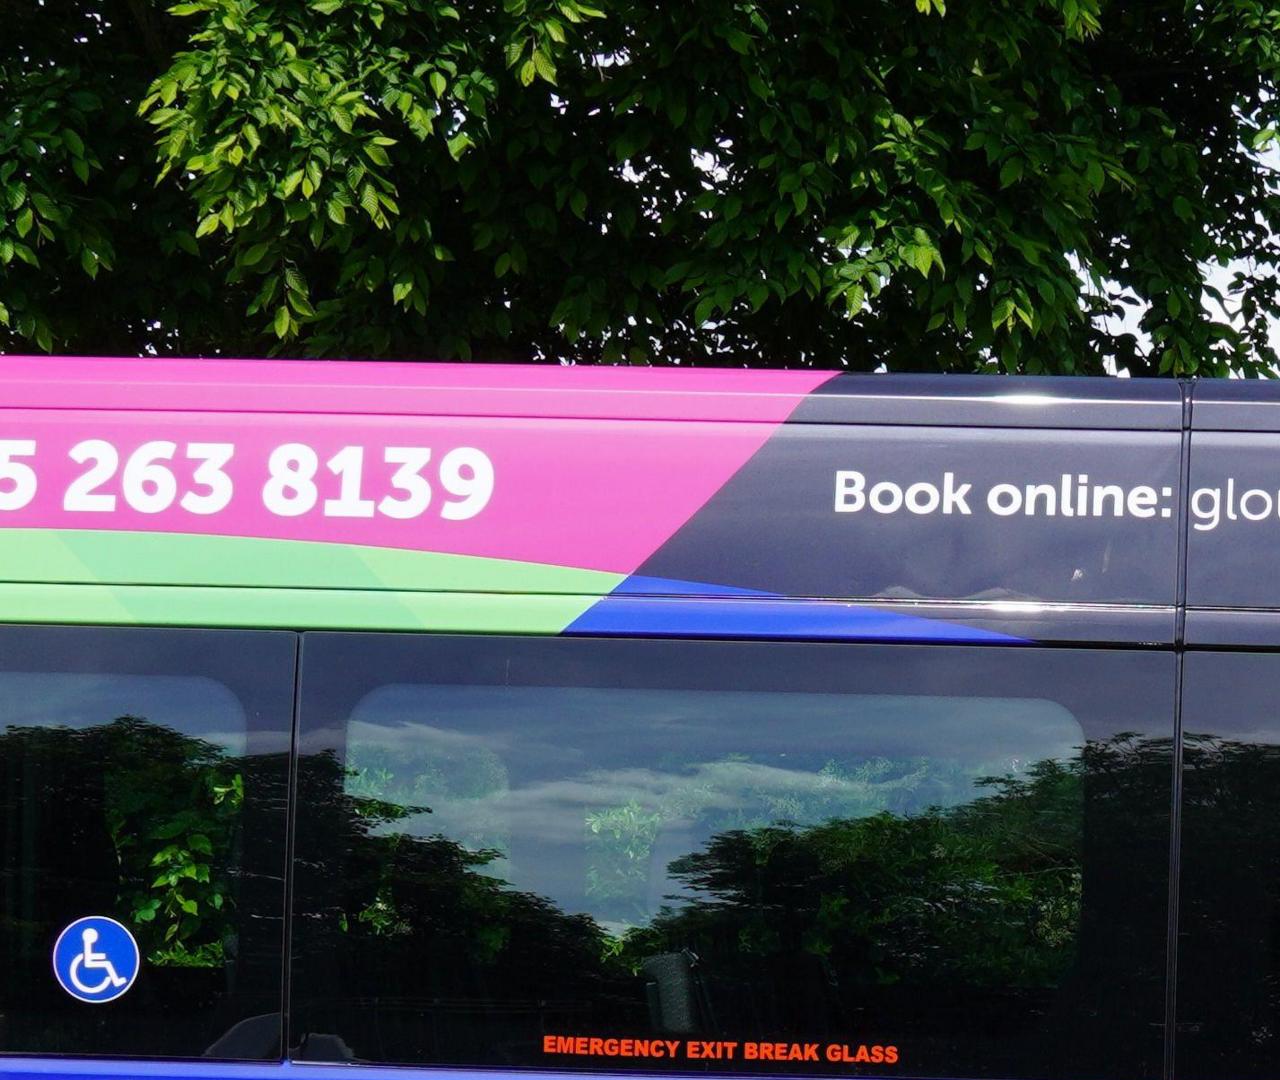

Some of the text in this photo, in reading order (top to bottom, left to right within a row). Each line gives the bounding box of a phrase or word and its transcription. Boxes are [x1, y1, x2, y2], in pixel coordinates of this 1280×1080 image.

[63, 438, 234, 515] 263
[262, 442, 495, 521] 8139
[834, 470, 972, 515] Book
[986, 473, 1172, 518] online:
[543, 1035, 899, 1064] EMERGENCY EXIT BREAK GLASS
